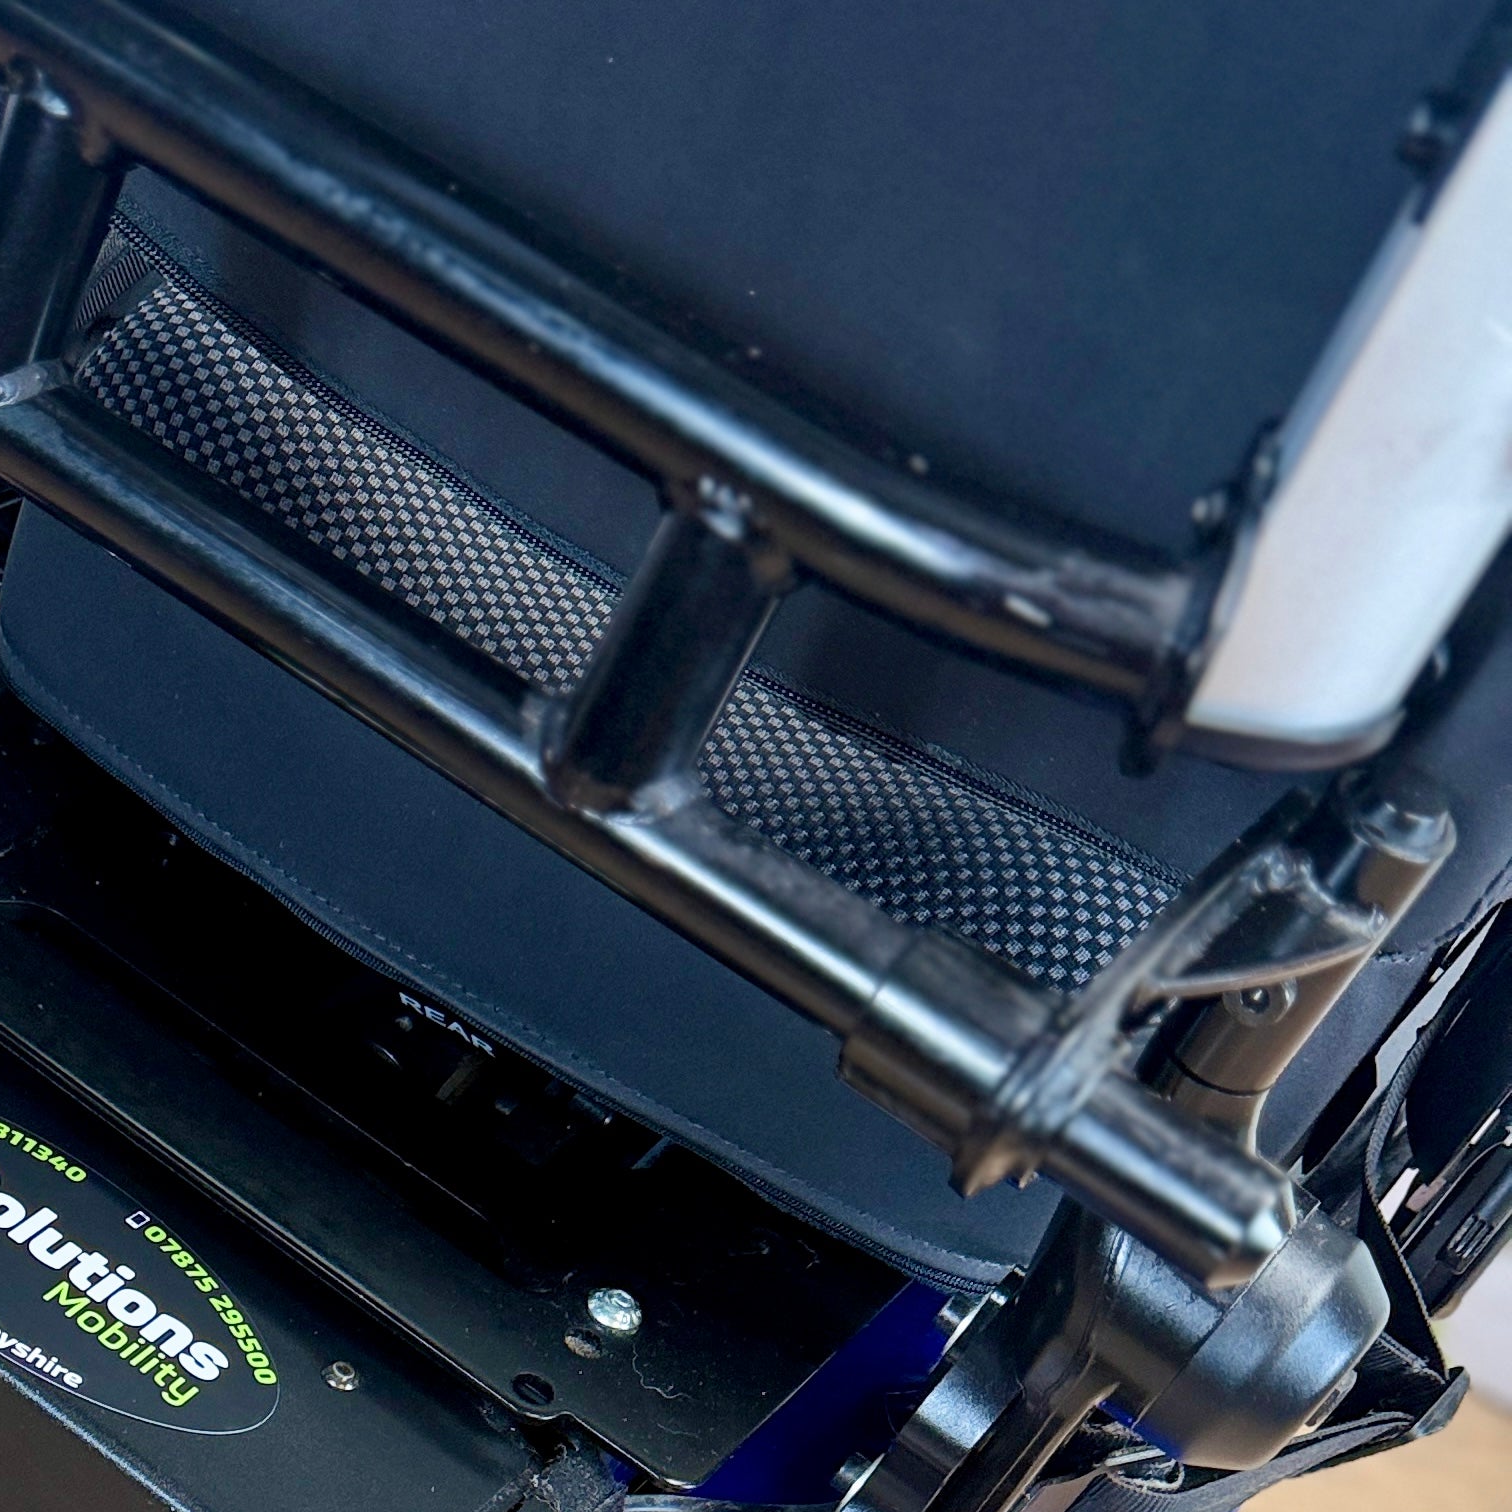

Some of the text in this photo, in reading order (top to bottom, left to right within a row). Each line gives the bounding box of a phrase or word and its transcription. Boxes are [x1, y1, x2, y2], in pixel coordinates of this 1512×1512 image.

[399, 992, 496, 1058] REAR
[42, 1280, 201, 1408] Mobility
[143, 1225, 278, 1386] 07875 295500
